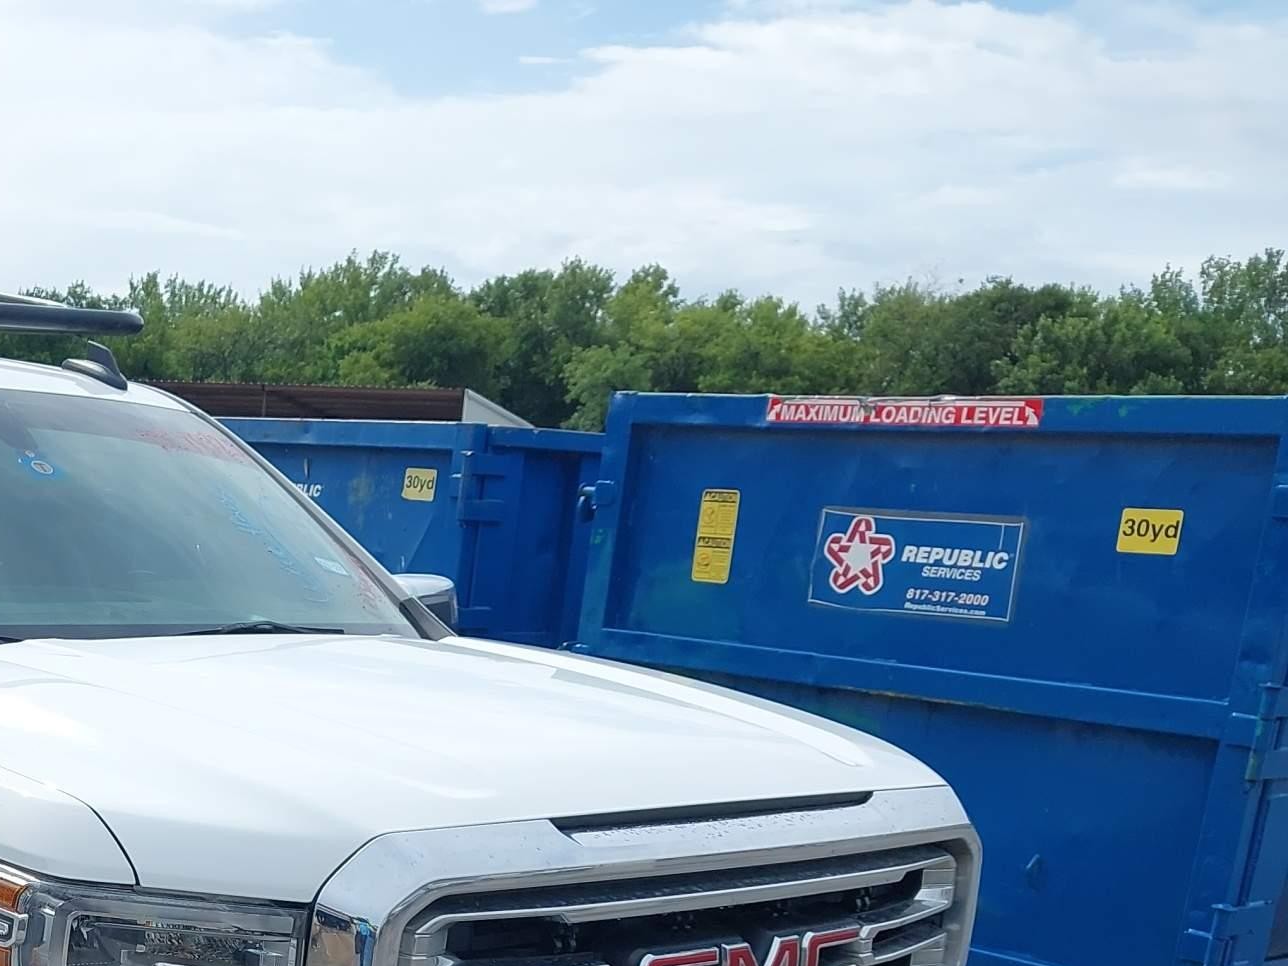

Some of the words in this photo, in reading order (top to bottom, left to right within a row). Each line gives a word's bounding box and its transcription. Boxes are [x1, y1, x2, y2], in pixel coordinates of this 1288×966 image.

[780, 403, 864, 422] MAXIMUM
[870, 406, 956, 424] LOADING
[961, 407, 1024, 425] LEVEL
[405, 475, 435, 493] 30yd
[1122, 518, 1180, 543] 30yd
[901, 545, 1010, 570] REPUBLIC
[921, 566, 982, 582] SERVICES
[906, 588, 990, 606] 817-317-2000
